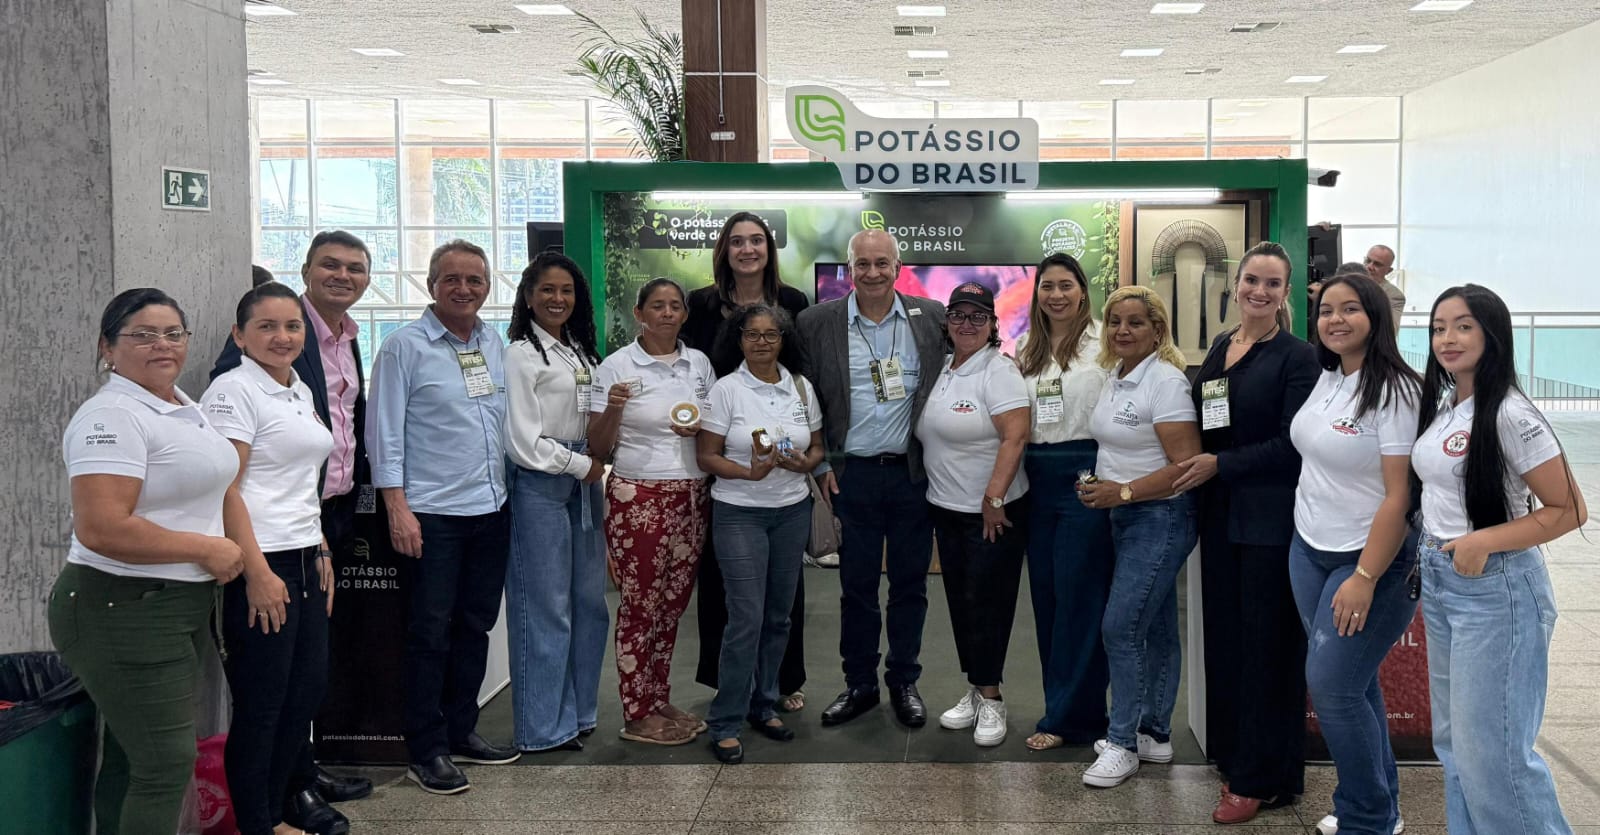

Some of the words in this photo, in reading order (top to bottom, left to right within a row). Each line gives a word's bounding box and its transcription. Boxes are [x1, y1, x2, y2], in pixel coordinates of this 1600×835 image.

[855, 124, 1020, 152] POTÁSSIO
[855, 163, 899, 184] DO
[912, 163, 1026, 184] BRASIL
[670, 217, 681, 227] O
[669, 230, 706, 240] verde
[888, 223, 963, 237] POTÁSSIO
[898, 241, 909, 251] O
[913, 241, 966, 251] BRASIL
[342, 564, 398, 577] OTÁSSIO
[354, 580, 400, 589] BRASIL
